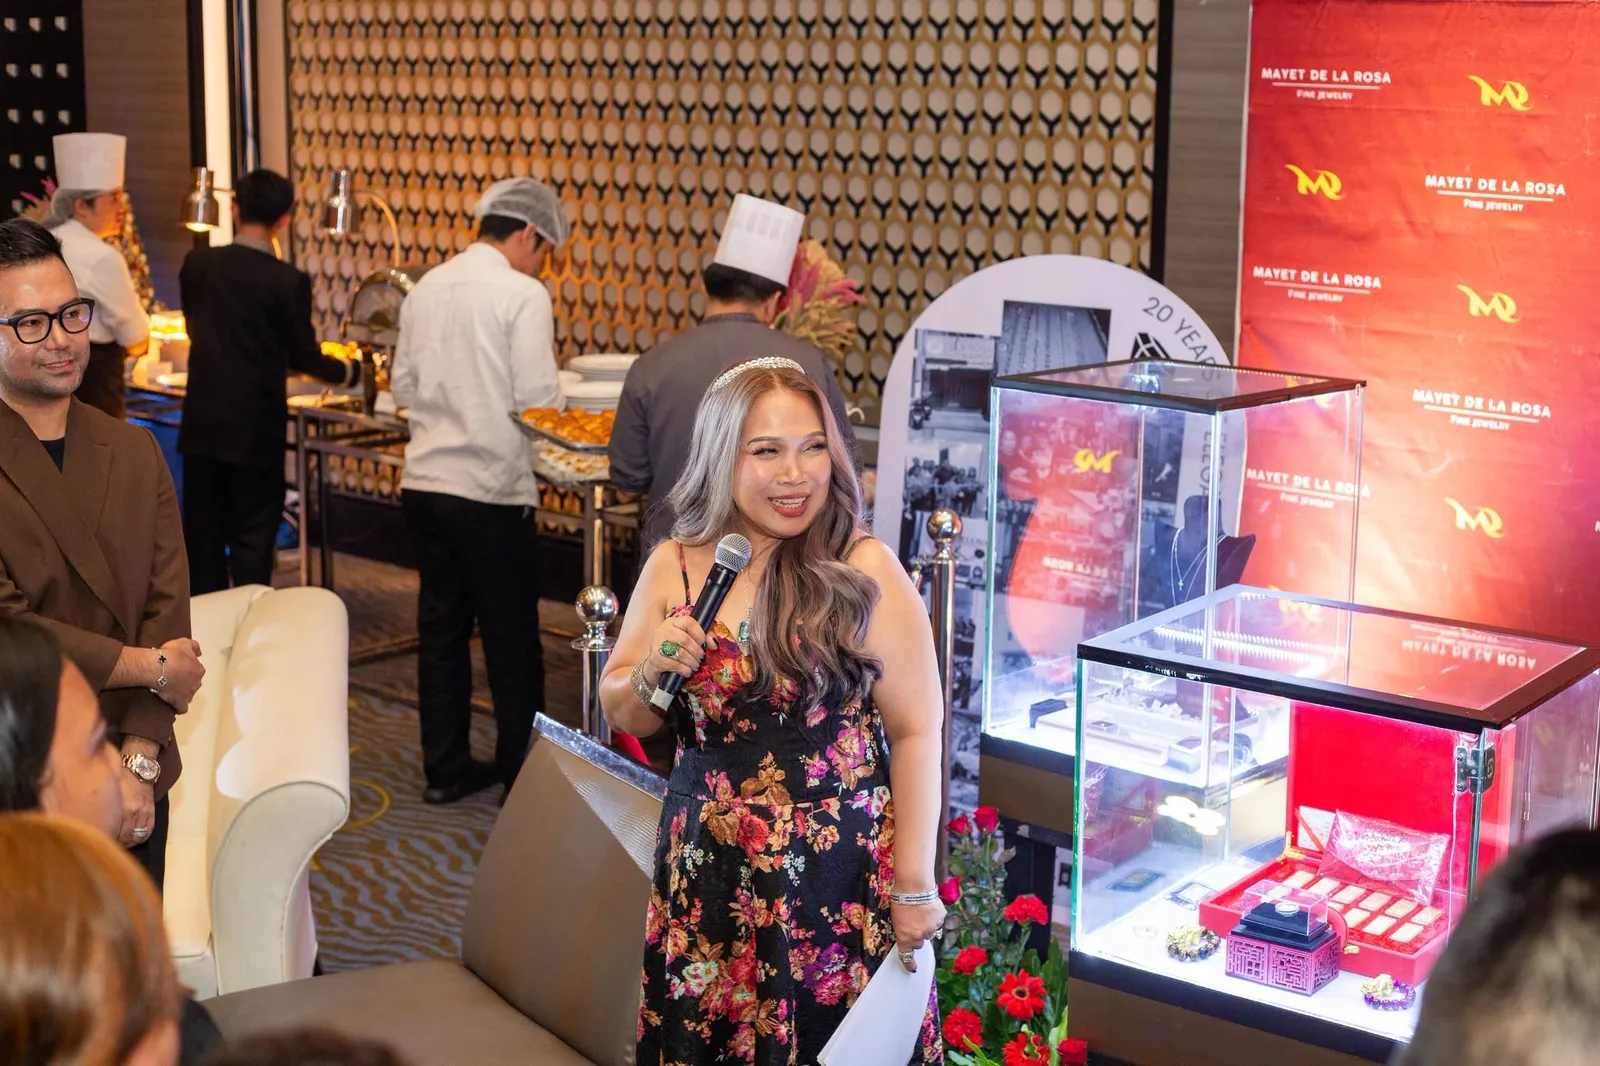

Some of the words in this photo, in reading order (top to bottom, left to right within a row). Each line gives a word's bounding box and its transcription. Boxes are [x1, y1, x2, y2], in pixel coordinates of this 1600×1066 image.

[1261, 68, 1305, 80] MAYET
[1310, 69, 1328, 81] DE
[1332, 70, 1349, 82] LA
[1354, 71, 1391, 84] ROSA
[1425, 175, 1473, 189] MAYET
[1478, 178, 1497, 191] DE
[1502, 180, 1520, 193] LA
[1525, 181, 1566, 196] ROSA
[1253, 265, 1297, 280] MAYET
[1301, 270, 1319, 283] DE
[1323, 272, 1340, 285] LA
[1344, 274, 1382, 289] ROSA
[1142, 296, 1174, 322] 20
[1413, 388, 1460, 406] MAYET
[1465, 395, 1484, 409] DE
[1489, 399, 1506, 412] LA
[1511, 401, 1551, 418] ROSA
[1246, 468, 1289, 485] MAYET
[1293, 474, 1311, 488] DE
[1315, 478, 1331, 492] LA
